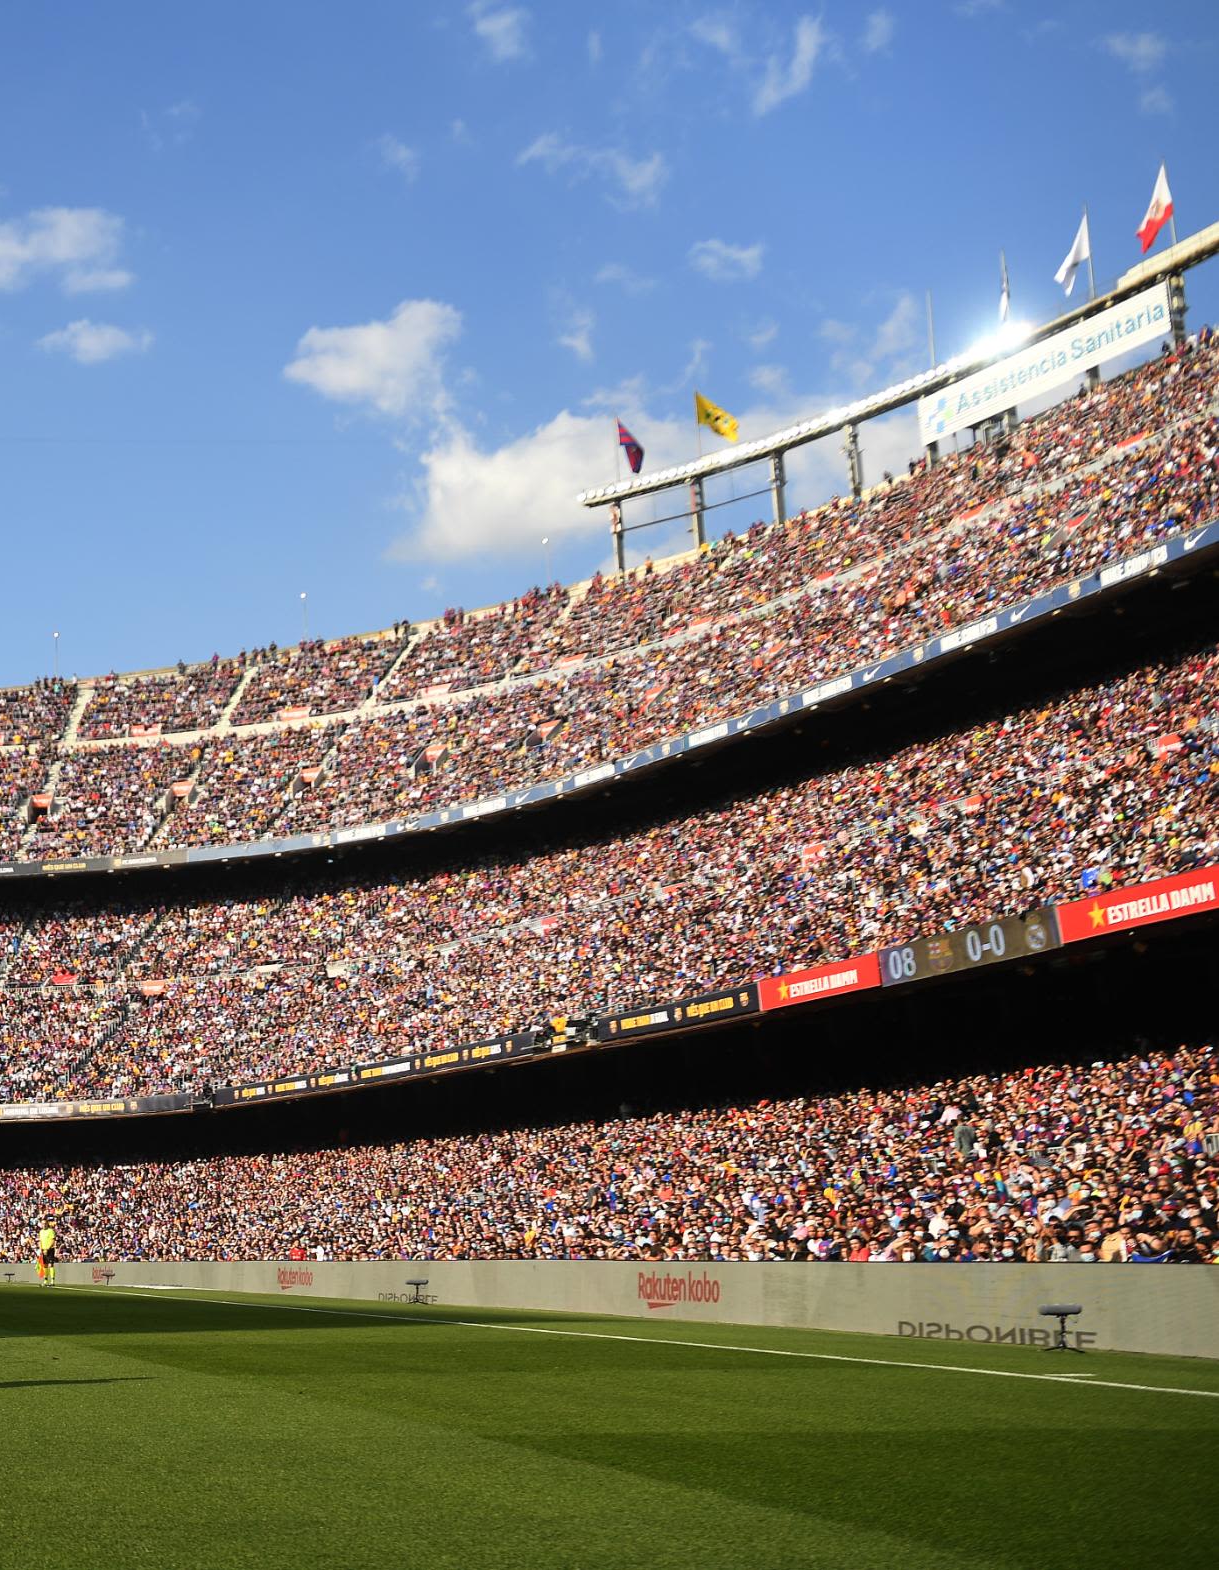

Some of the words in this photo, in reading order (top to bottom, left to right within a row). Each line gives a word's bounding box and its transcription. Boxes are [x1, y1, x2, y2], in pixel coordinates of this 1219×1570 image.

[1107, 892, 1170, 925] ESTRELLA
[1171, 881, 1216, 912] DAMM
[966, 924, 1006, 962] 0-0
[888, 947, 916, 980] 08
[789, 975, 830, 998] ESTRELLA
[277, 1267, 298, 1286] Rakuten
[299, 1267, 313, 1287] kobo
[638, 1271, 686, 1301] Rakuten
[688, 1270, 721, 1303] kobo
